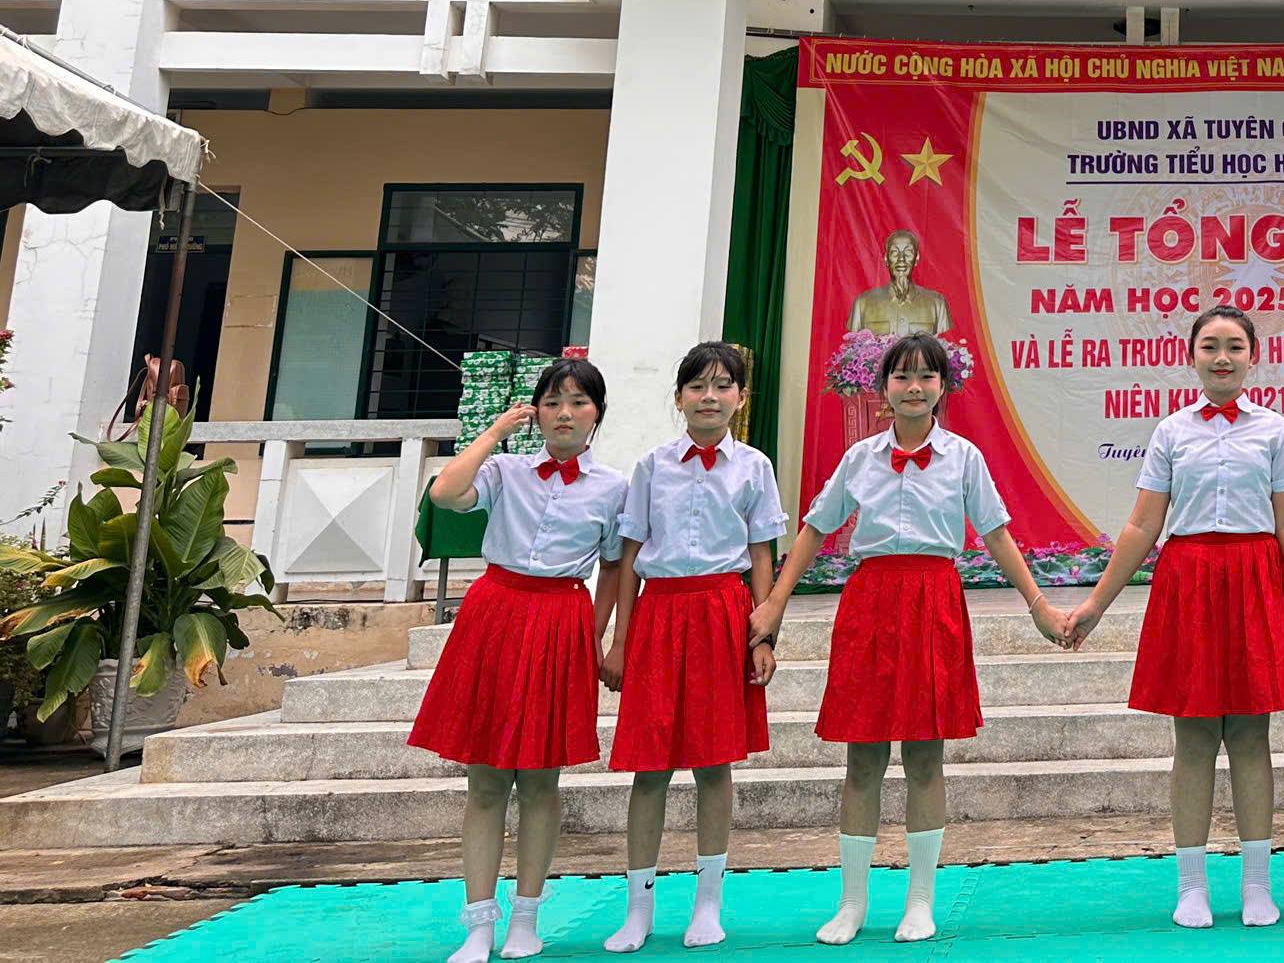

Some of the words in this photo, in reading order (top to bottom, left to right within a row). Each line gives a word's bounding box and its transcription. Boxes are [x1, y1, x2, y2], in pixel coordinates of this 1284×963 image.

[825, 49, 887, 75] NƯỚC
[894, 52, 953, 80] CỘNG
[960, 53, 1003, 79] HÒA
[1010, 55, 1038, 78] XÃ
[1045, 55, 1081, 83] HỘI
[1087, 54, 1129, 78] CHỦ
[1136, 56, 1201, 79] NGHĨA
[1206, 55, 1250, 81] VIỆT
[1097, 120, 1159, 140] UBND
[1167, 116, 1197, 140] XÃ
[1204, 115, 1275, 140] TUYÊN
[1067, 149, 1159, 174] TRƯỜNG
[1165, 145, 1215, 174] TIỂU
[1222, 153, 1267, 179] HỌC
[1016, 198, 1089, 264] LỄ
[1030, 283, 1114, 314] NĂM
[1127, 286, 1200, 320] HỌC
[1011, 333, 1041, 369] VÀ
[1047, 328, 1074, 369] LỄ
[1081, 338, 1112, 368] RA
[1119, 331, 1194, 367] TRƯỜN
[1104, 383, 1161, 419] NIÊN
